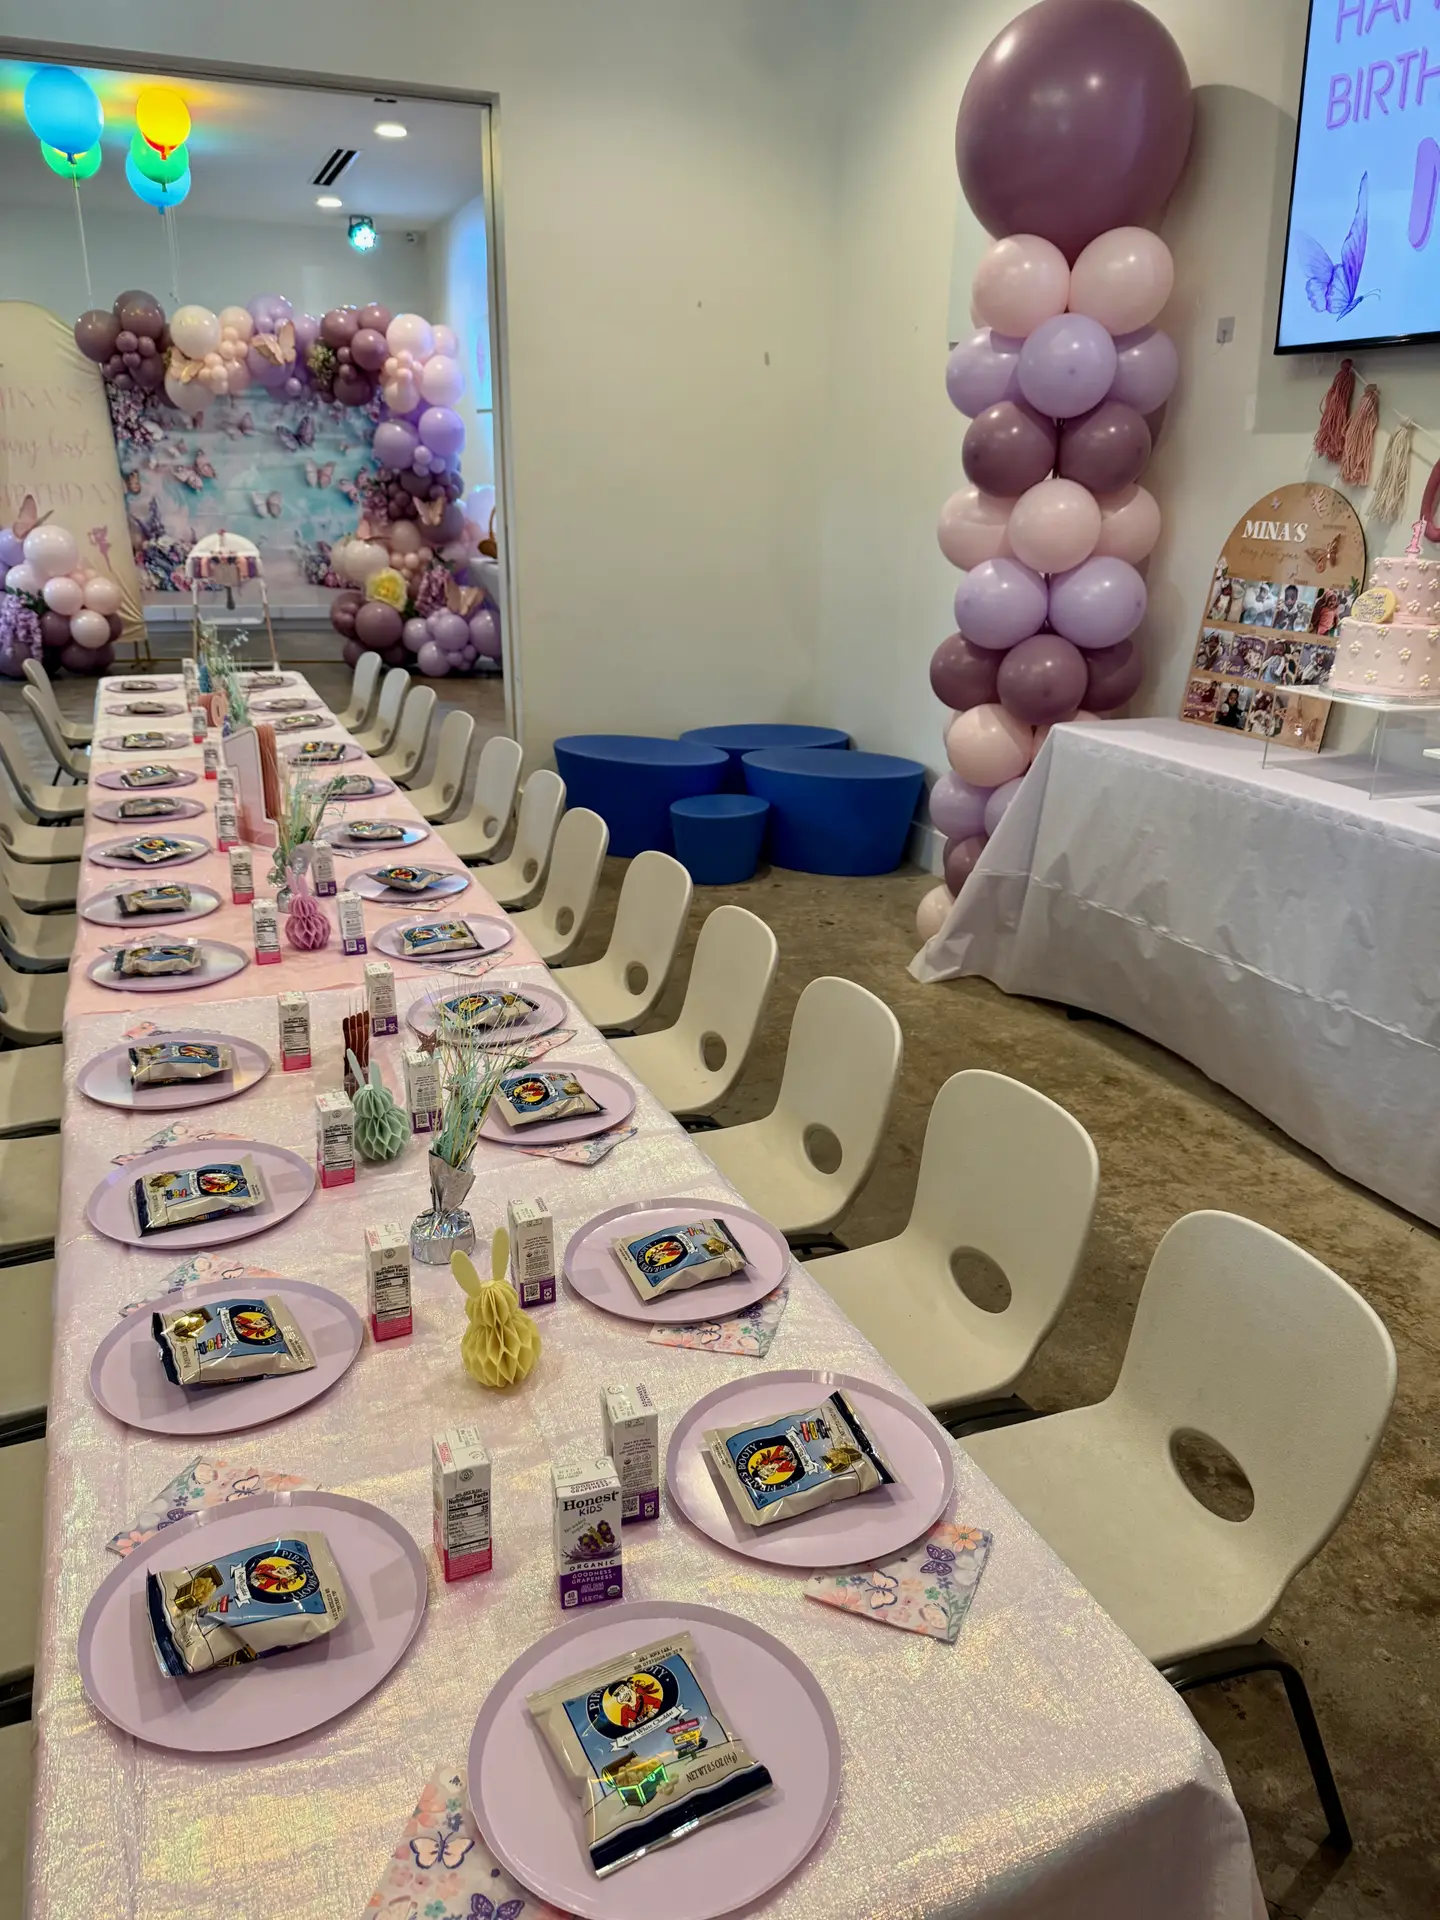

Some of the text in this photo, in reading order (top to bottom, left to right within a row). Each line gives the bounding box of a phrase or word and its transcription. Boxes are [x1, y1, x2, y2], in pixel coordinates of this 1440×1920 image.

[1242, 520, 1308, 543] MINA'S
[563, 1490, 620, 1512] Honest
[569, 1559, 615, 1572] ORGANIC
[571, 1574, 613, 1585] GRAPENESS
[572, 1569, 612, 1579] GOODNESS
